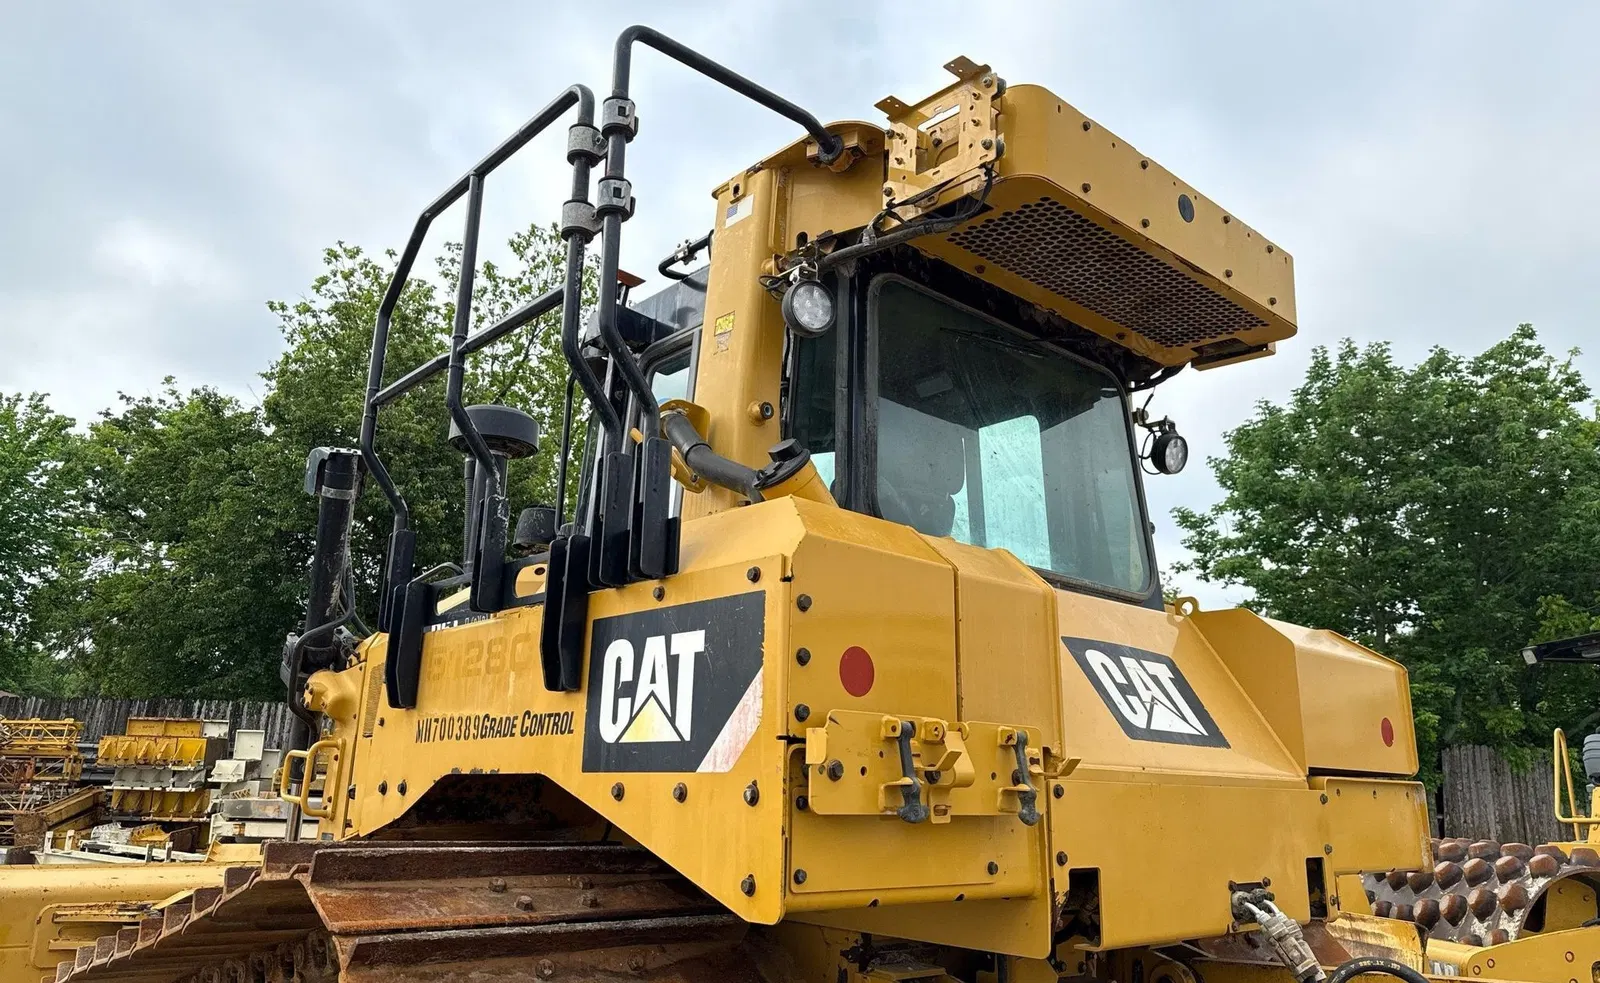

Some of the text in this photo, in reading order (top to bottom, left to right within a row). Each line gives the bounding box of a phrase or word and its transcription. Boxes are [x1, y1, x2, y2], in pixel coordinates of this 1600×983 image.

[520, 710, 575, 738] CONTROL
[599, 629, 706, 744] CAT
[1085, 649, 1209, 736] CAT
